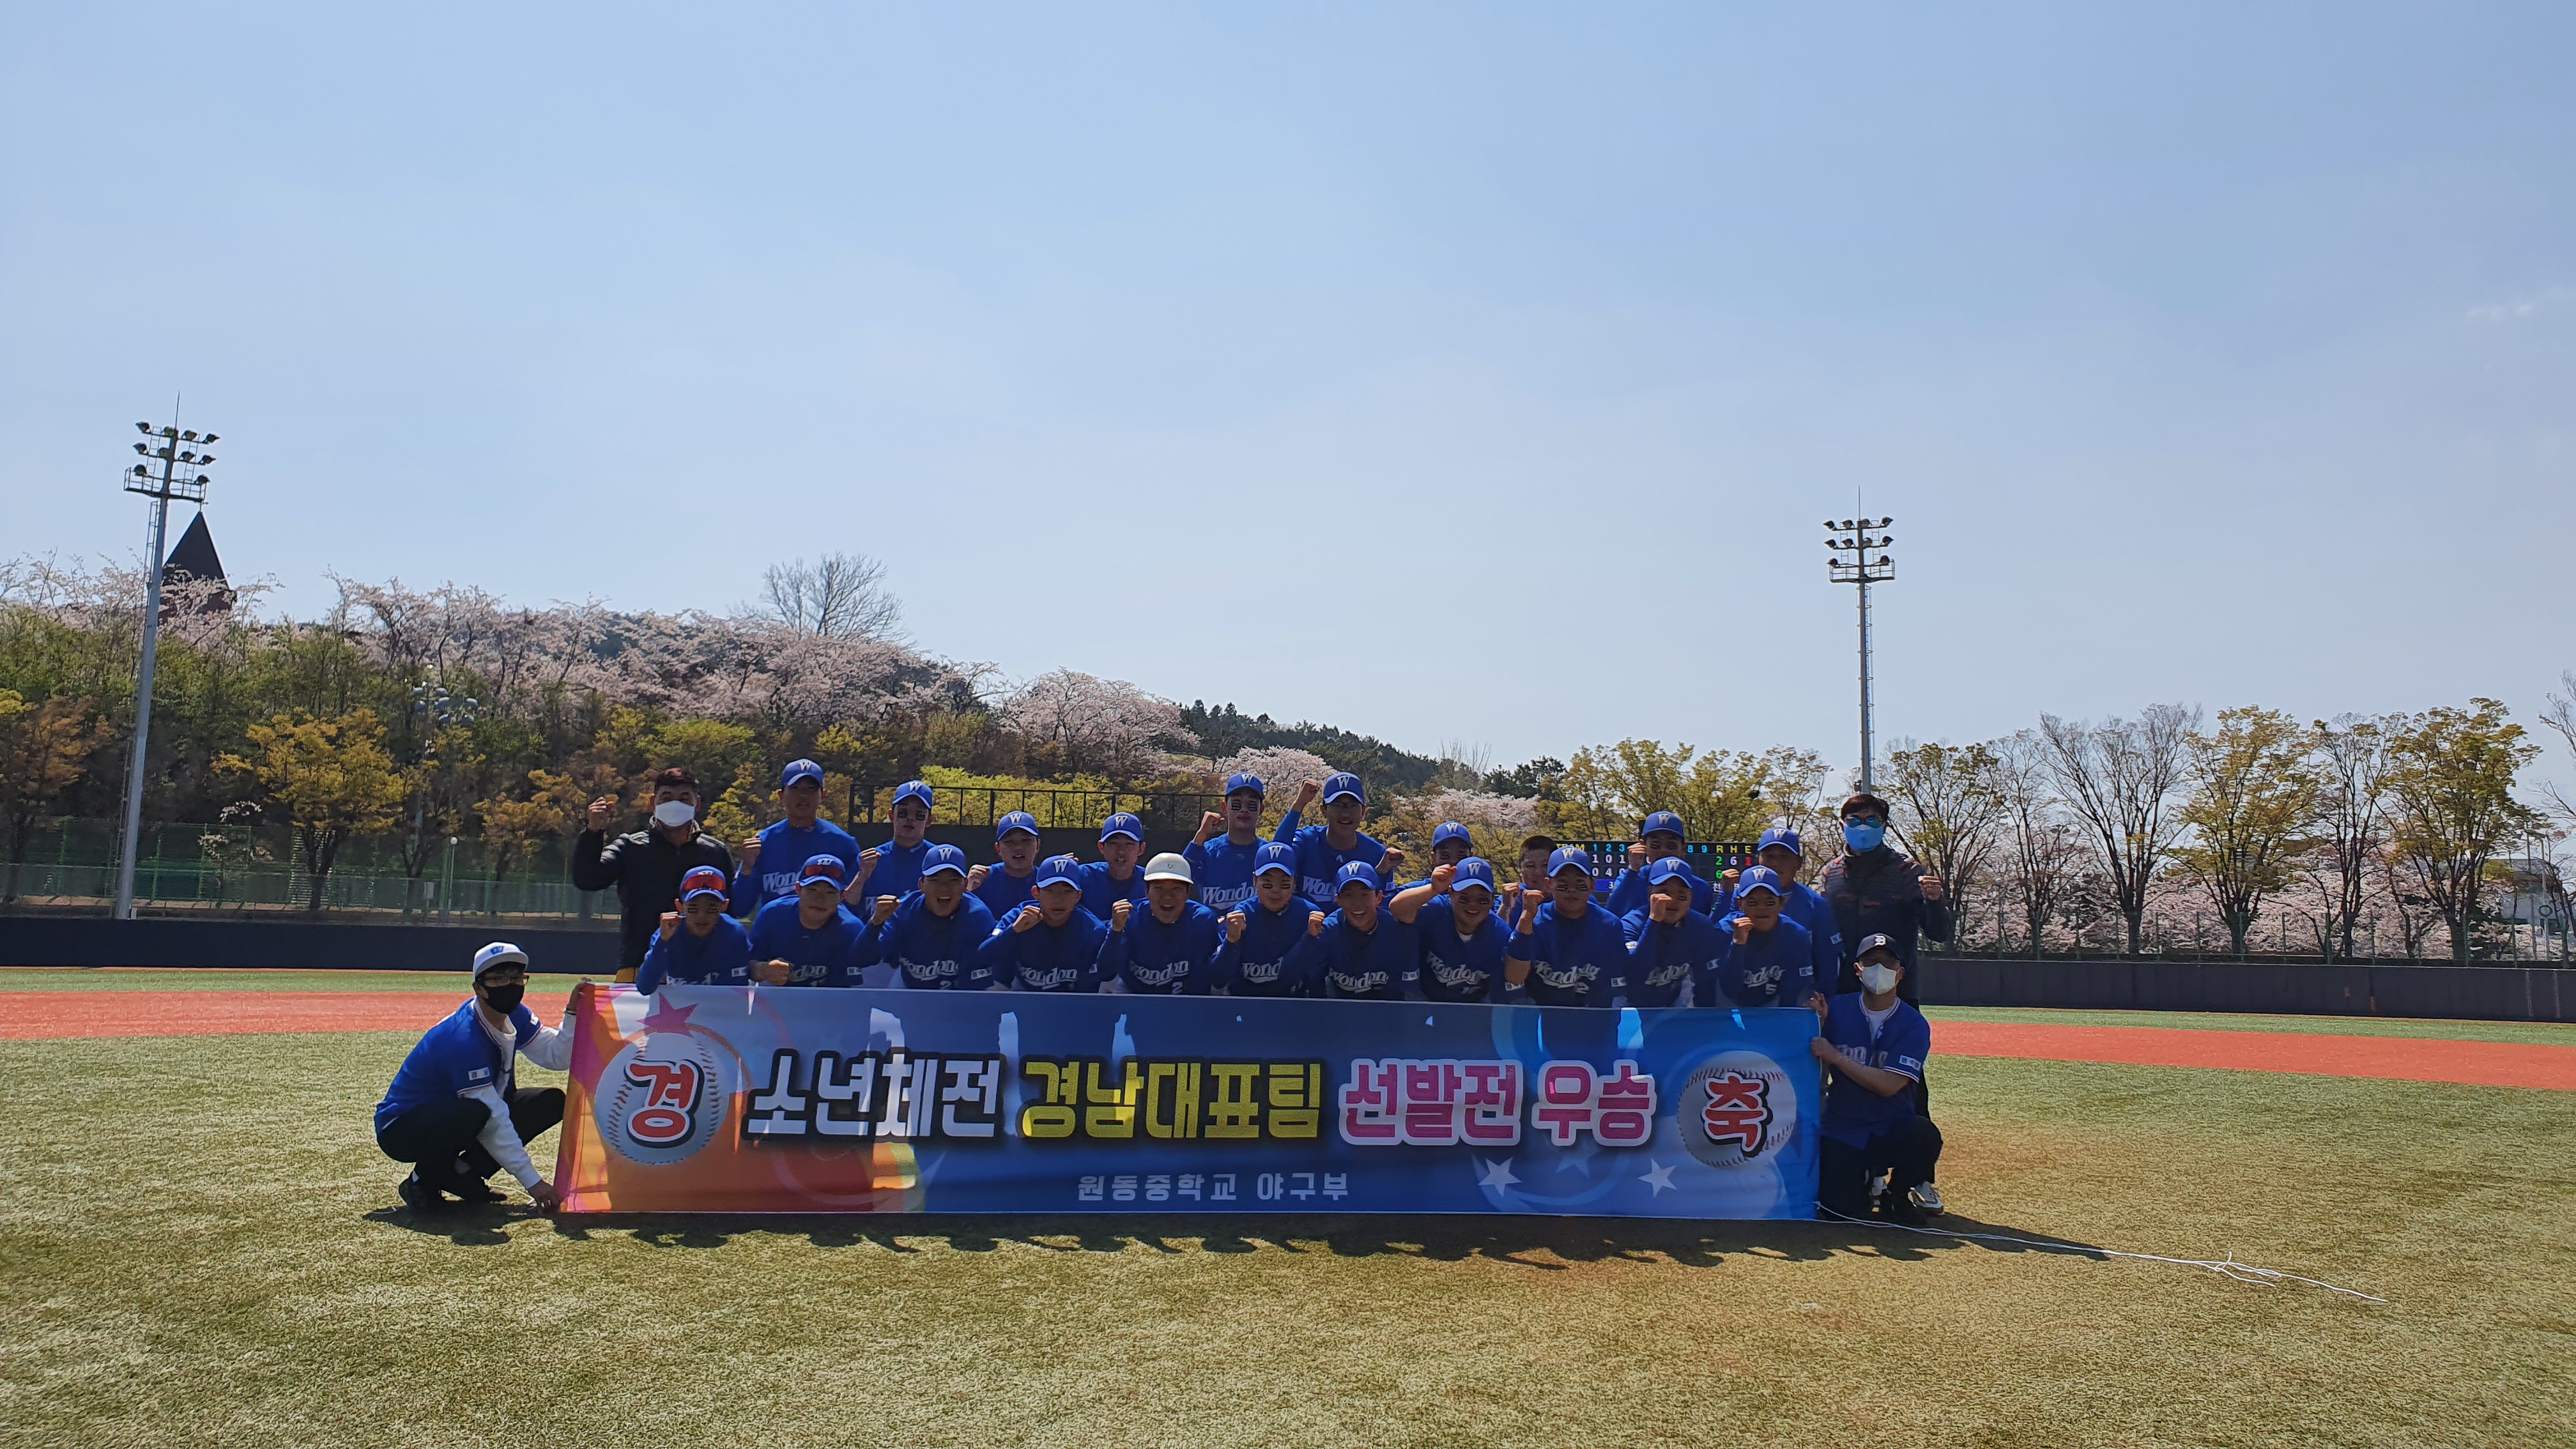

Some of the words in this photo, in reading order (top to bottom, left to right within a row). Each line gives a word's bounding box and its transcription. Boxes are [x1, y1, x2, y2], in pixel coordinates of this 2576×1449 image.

[799, 761, 812, 771] W
[1241, 774, 1254, 784] W
[1337, 775, 1351, 789] W
[909, 781, 922, 792] W
[1009, 813, 1022, 824] W
[1114, 815, 1129, 828] W
[1657, 813, 1671, 825] W
[1446, 822, 1459, 834] W
[1773, 829, 1787, 839] W
[939, 847, 953, 861] W
[1268, 845, 1284, 859] W
[1561, 847, 1575, 860] W
[1593, 843, 1597, 852] 1
[1606, 843, 1612, 852] 2
[1618, 843, 1625, 852] 3
[1687, 845, 1694, 853] 8
[1701, 845, 1708, 853] 9
[1716, 845, 1724, 853] R
[1745, 845, 1752, 854] E
[1053, 859, 1069, 873] W
[1592, 854, 1599, 864] 1
[1605, 854, 1613, 864] 0
[1619, 854, 1626, 864] 1
[1715, 856, 1722, 865] 2
[1729, 856, 1737, 865] 6
[1665, 859, 1682, 871] W
[1346, 862, 1360, 876] W
[1468, 862, 1481, 876] W
[1591, 867, 1599, 877] 0
[1605, 868, 1613, 877] 4
[1715, 870, 1722, 878] 6
[1752, 868, 1767, 881] W
[1608, 881, 1614, 889] 3
[627, 1059, 700, 1142] 경
[746, 1052, 1002, 1138] 소년체전
[1021, 1060, 1321, 1139] 경남대표팀
[1342, 1061, 1520, 1142] 선발전
[1535, 1062, 1653, 1143] 우승
[1705, 1071, 1767, 1152] 축
[1078, 1173, 1237, 1201] 원동중학교
[1256, 1172, 1349, 1201] 야구부
